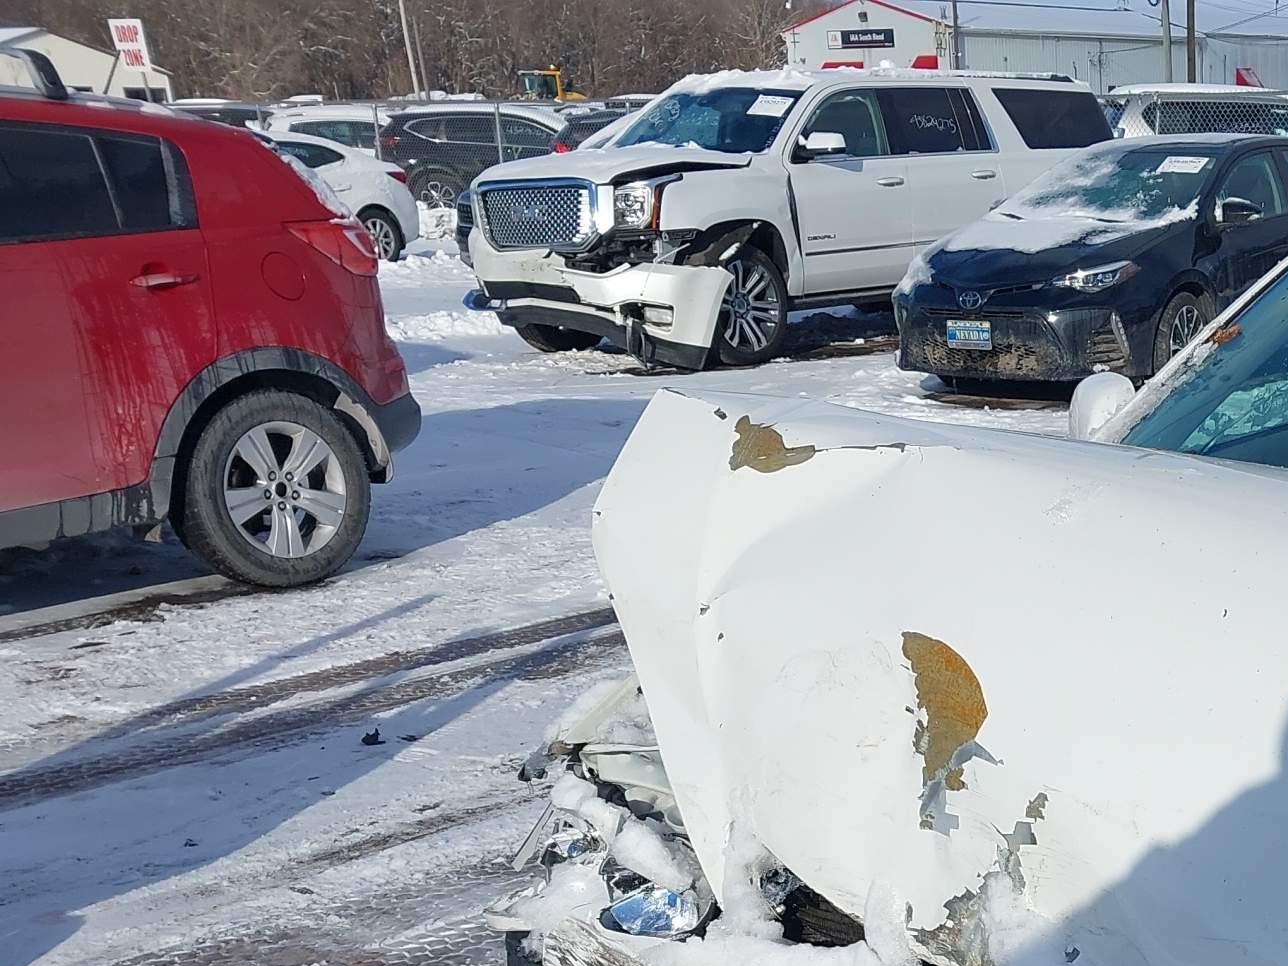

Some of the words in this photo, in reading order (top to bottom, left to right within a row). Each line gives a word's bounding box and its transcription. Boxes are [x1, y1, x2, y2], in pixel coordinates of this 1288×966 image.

[113, 24, 138, 43] DROP
[122, 48, 145, 66] ZONE
[807, 233, 837, 241] DENALI
[955, 330, 983, 341] NEVADA
